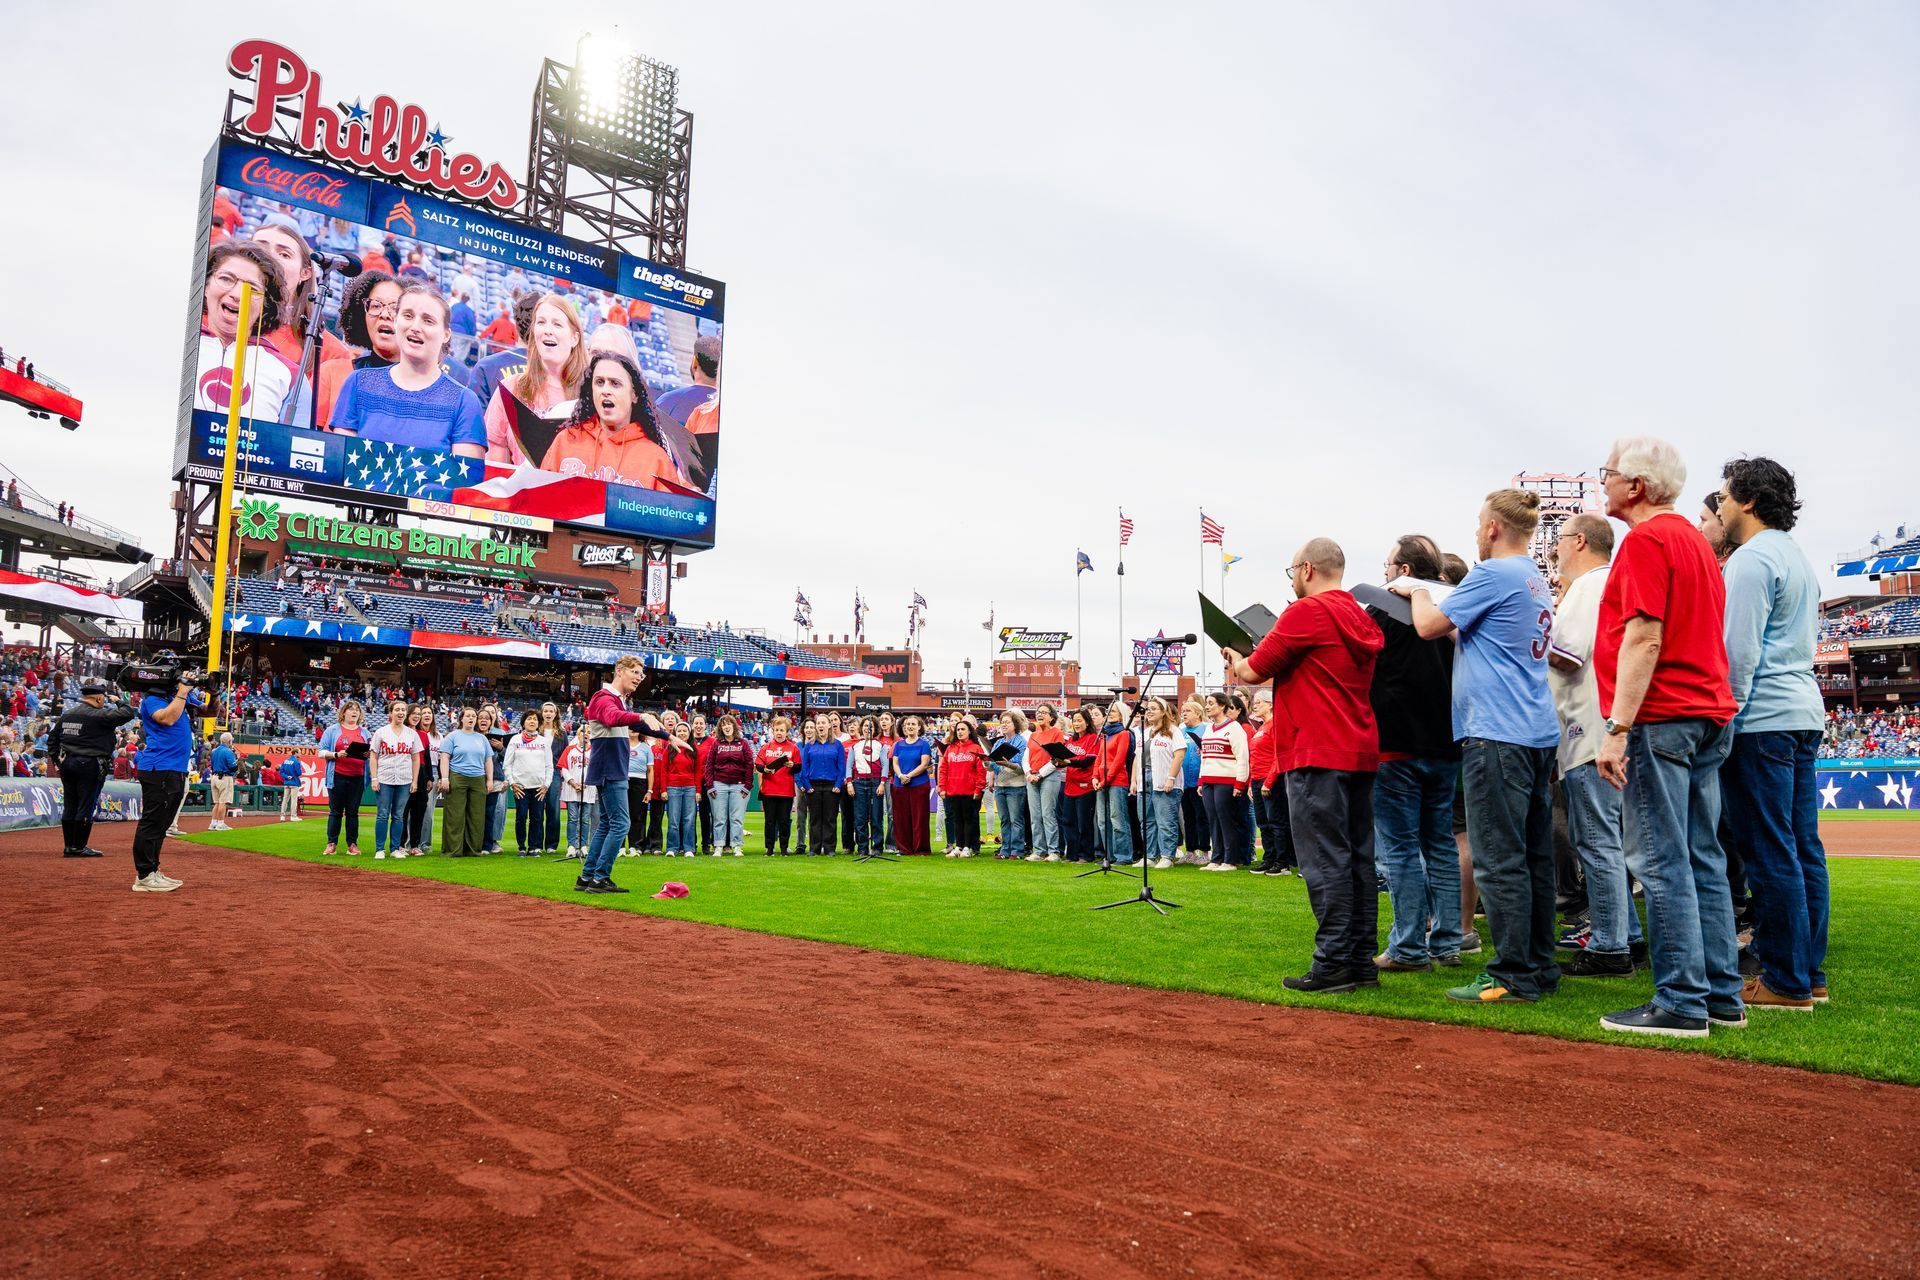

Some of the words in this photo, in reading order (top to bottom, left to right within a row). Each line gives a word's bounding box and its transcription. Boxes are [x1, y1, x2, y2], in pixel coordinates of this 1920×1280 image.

[226, 37, 518, 209] Phillies
[422, 209, 459, 228] SALTZ
[465, 221, 542, 251] MONGELUZZI
[547, 244, 605, 269] BENDESKY
[459, 236, 506, 256] INJURY
[516, 252, 571, 274] LAWYERS
[633, 266, 714, 299] theScore
[210, 421, 257, 440] Driing
[209, 435, 259, 451] smrter
[208, 448, 274, 465] ouomes.
[239, 473, 258, 486] LANE
[259, 477, 269, 487] AT
[287, 480, 305, 493] WHY.
[618, 498, 694, 521] Independence
[286, 512, 403, 550] Citizens
[408, 528, 476, 560] Bank
[480, 538, 536, 568] Park
[582, 545, 625, 566] GHOST
[1004, 629, 1064, 643] Fitzpatrick
[1530, 608, 1552, 661] 3
[1821, 643, 1844, 654] SIGN
[866, 664, 905, 674] GIANT
